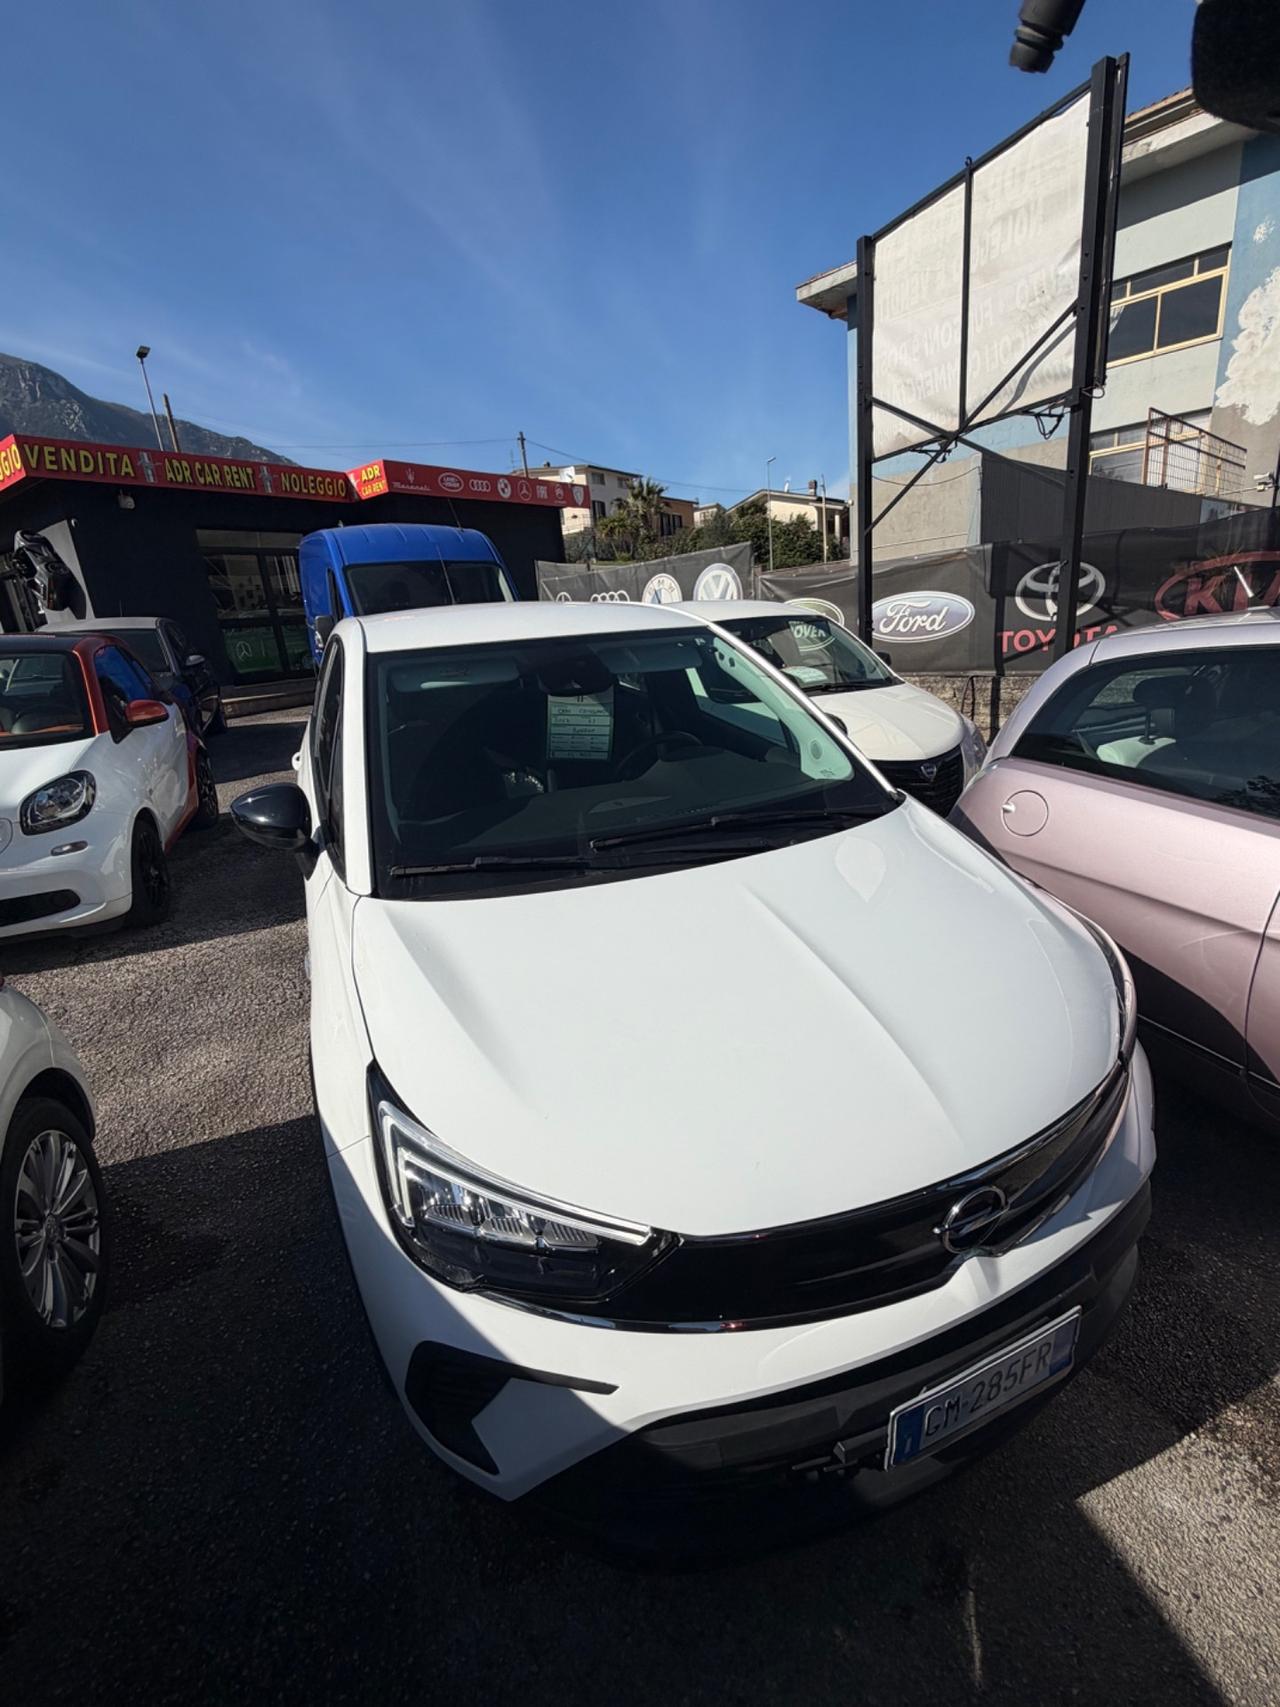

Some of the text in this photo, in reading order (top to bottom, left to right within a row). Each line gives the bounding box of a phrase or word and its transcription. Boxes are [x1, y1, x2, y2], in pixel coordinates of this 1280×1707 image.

[24, 443, 136, 477] VENDITA
[164, 457, 255, 489] ADR CAR RENT
[361, 464, 381, 482] ADR
[280, 473, 346, 497] NOLEGGIO
[879, 600, 949, 633] Ford
[924, 1342, 1051, 1436] GM 285FR
